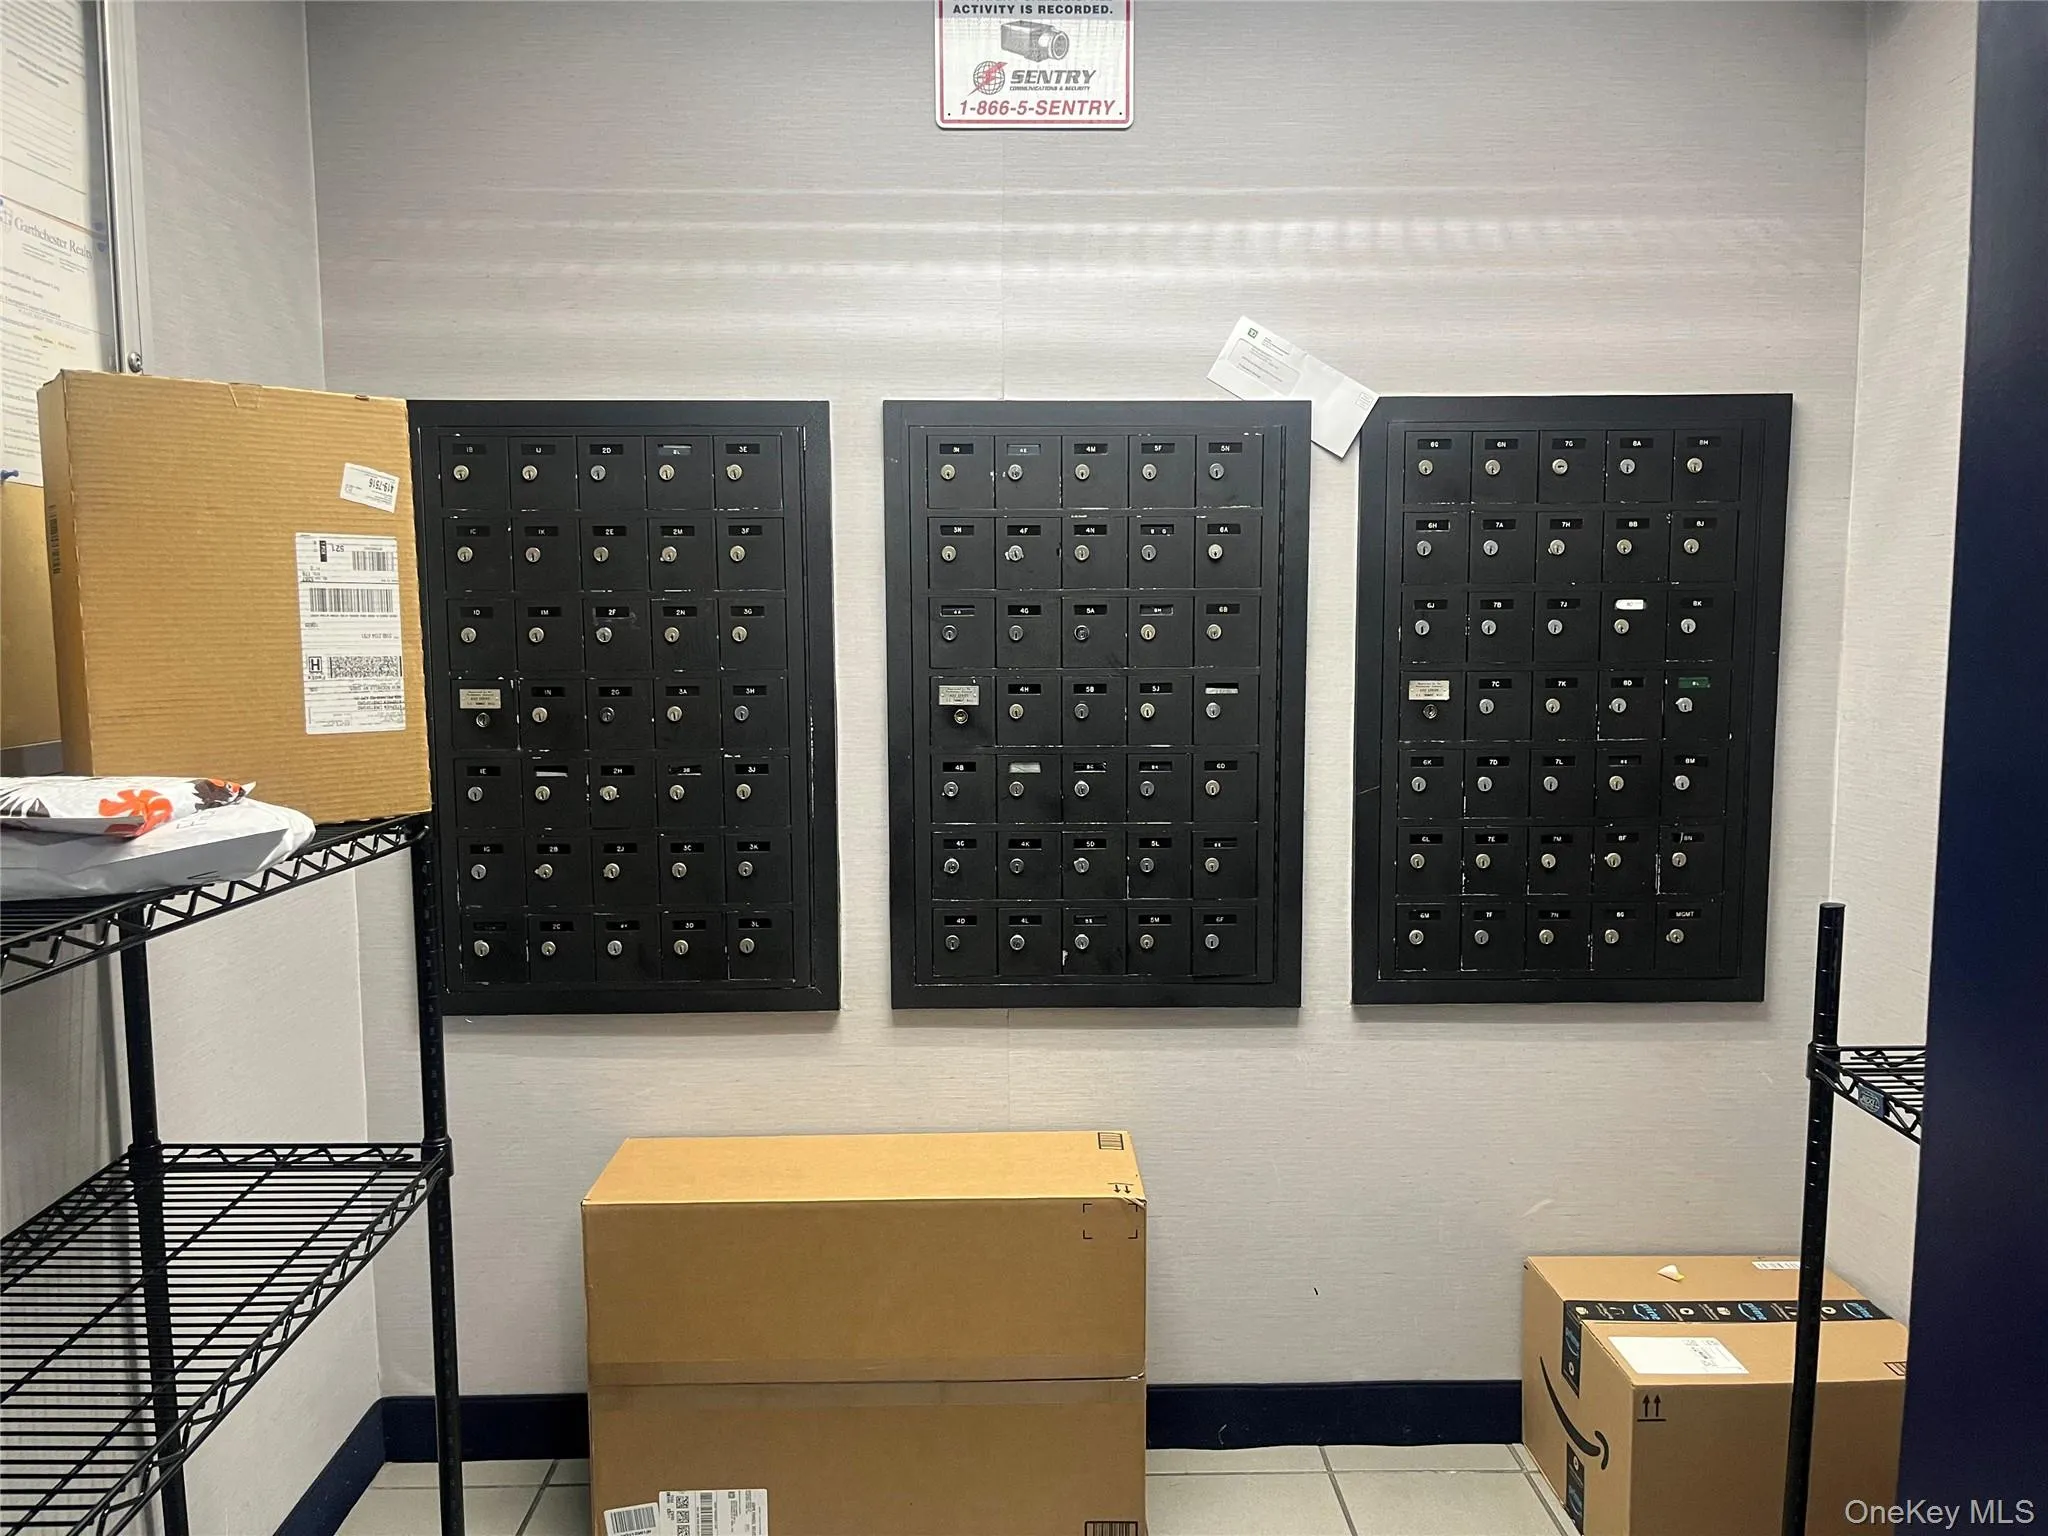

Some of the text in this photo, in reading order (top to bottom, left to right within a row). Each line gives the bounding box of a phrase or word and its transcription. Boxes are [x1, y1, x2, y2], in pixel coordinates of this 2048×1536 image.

[953, 4, 1113, 15] ACTIVITY IS RECORDED.
[1010, 69, 1097, 85] SENTRY
[959, 99, 1116, 116] 1-866-5-SENTRY
[14, 216, 68, 249] Garthchester
[311, 658, 321, 671] H
